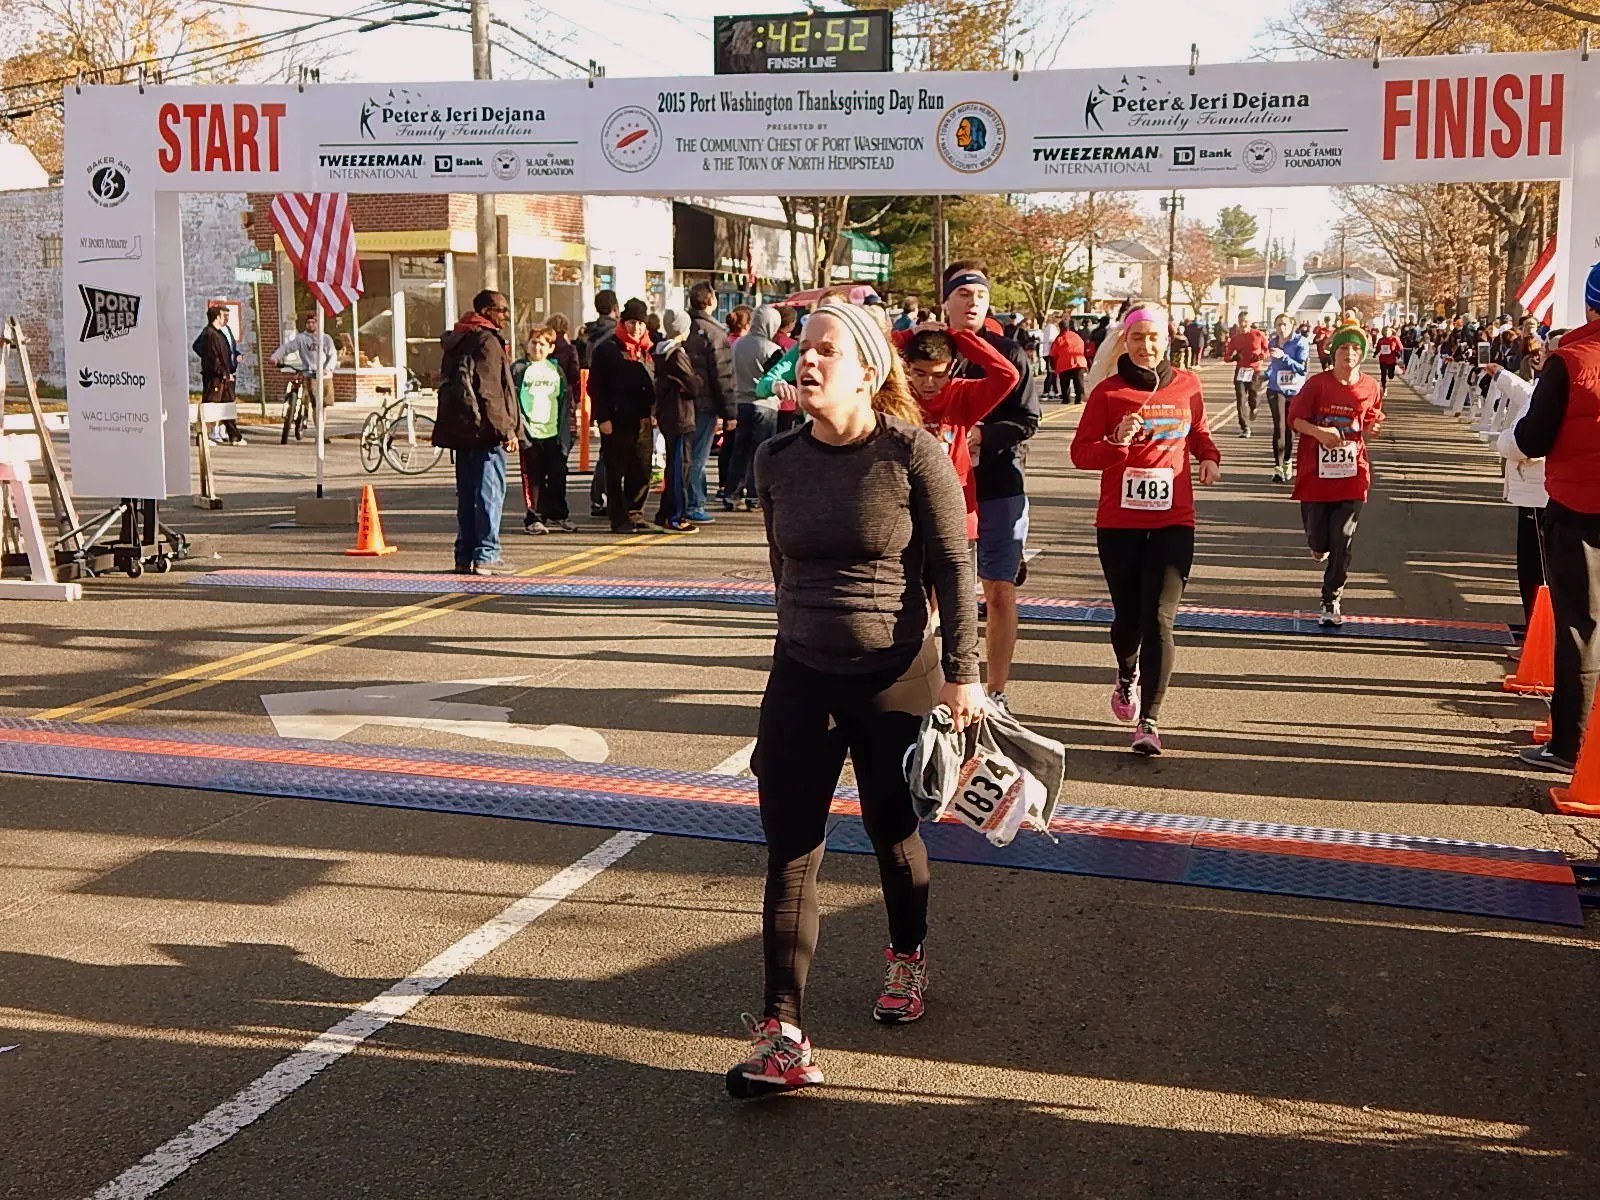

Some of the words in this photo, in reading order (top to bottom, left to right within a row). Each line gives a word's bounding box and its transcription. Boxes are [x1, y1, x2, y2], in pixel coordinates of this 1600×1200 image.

[767, 57, 806, 69] FINISH
[809, 56, 837, 68] LINE
[658, 92, 685, 112] 2015
[690, 92, 716, 112] Port
[720, 91, 793, 116] Washington
[797, 89, 885, 115] Thanksgiving
[889, 89, 914, 114] Day
[918, 89, 944, 110] Run
[1112, 95, 1169, 112] Peter
[1171, 96, 1185, 110] &
[1190, 93, 1227, 110] Jeri
[1232, 92, 1309, 111] Dejana
[382, 107, 428, 123] Peter
[430, 109, 441, 122] &
[446, 107, 478, 122] Jeri
[482, 106, 545, 124] Dejana
[1128, 113, 1189, 131] Family
[1197, 111, 1292, 125] Foundation
[1383, 74, 1564, 160] FINISH
[158, 103, 286, 173] START
[395, 124, 446, 140] Family
[452, 123, 533, 136] Foundation
[676, 138, 697, 153] THE
[700, 138, 764, 153] COMMUNITY
[767, 137, 802, 152] CHEST
[805, 138, 819, 151] OF
[823, 137, 850, 151] PORT
[855, 136, 924, 151] WASHINGTON
[1284, 148, 1311, 158] SLADE
[1314, 147, 1343, 157] FAMILY
[319, 154, 423, 167] TWEEZERMAN
[456, 157, 483, 166] Bank
[1033, 146, 1159, 161] TWEEZERMAN
[1175, 148, 1194, 164] TD
[1199, 148, 1232, 158] Bank
[87, 156, 115, 174] BAKER
[526, 158, 549, 167] SLADE
[551, 158, 574, 166] FAMILY
[702, 158, 711, 171] &
[713, 157, 734, 171] THE
[737, 156, 768, 171] TOWN
[771, 157, 785, 170] OF
[788, 156, 825, 170] NORTH
[828, 155, 895, 170] HEMPSTEAD
[1044, 161, 1152, 174] INTERNATIONAL
[1285, 158, 1342, 168] FOUNDATION
[329, 168, 418, 179] INTERNATIONAL
[527, 167, 574, 176] FOUNDATION
[80, 237, 88, 248] NY
[95, 291, 137, 312] PORT
[96, 311, 136, 333] BEER
[93, 370, 146, 389] Stop&Shop
[82, 410, 103, 421] WAC
[104, 411, 150, 423] LIGHTING
[1321, 449, 1354, 463] 2834
[1126, 479, 1169, 499] 1483
[955, 759, 1014, 826] 1834
